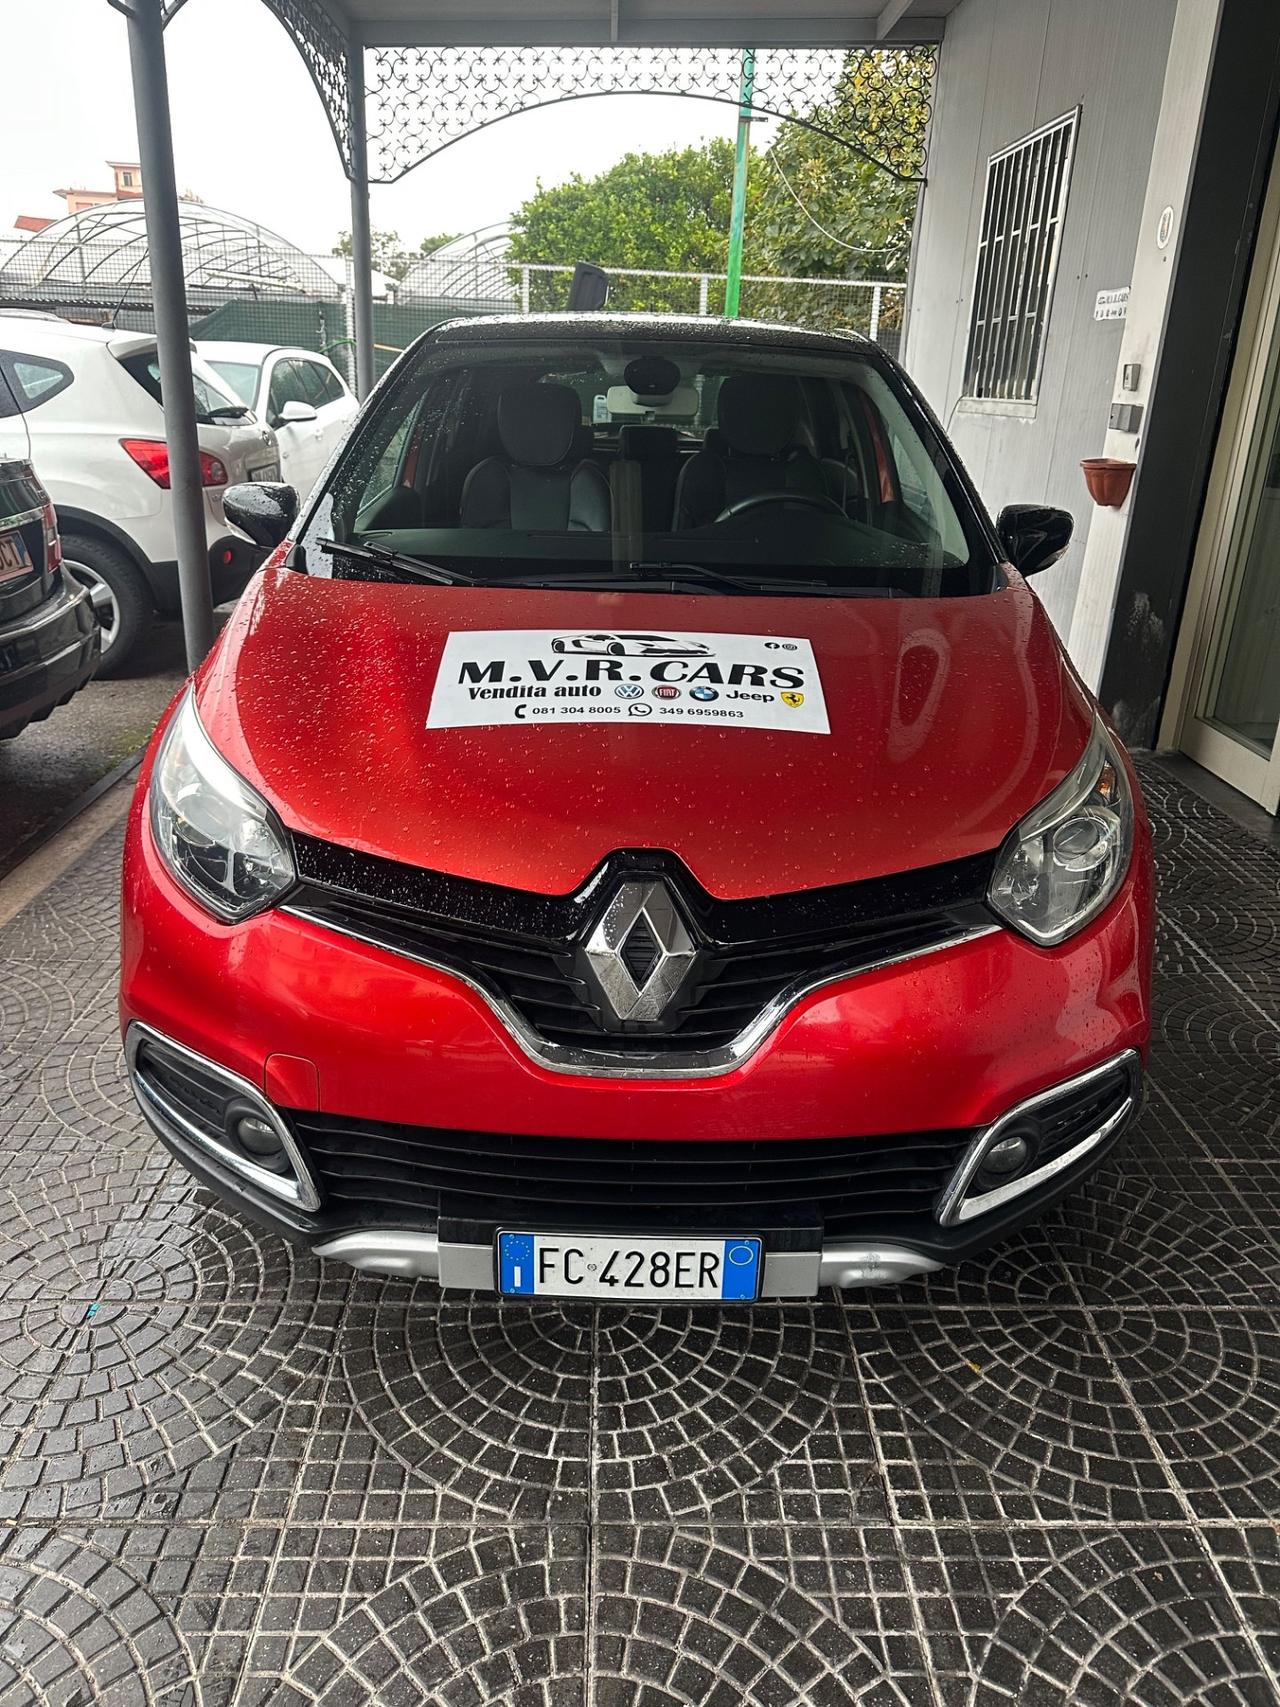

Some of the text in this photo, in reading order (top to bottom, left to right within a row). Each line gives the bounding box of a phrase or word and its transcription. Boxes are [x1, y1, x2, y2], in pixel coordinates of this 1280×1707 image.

[468, 684, 602, 700] Vendita auto
[726, 690, 775, 703] Jeep
[532, 706, 621, 715] 081 304 8005
[659, 706, 745, 718] 349 6959863
[539, 1247, 720, 1288] FC 428ER
[514, 1265, 522, 1288] I
